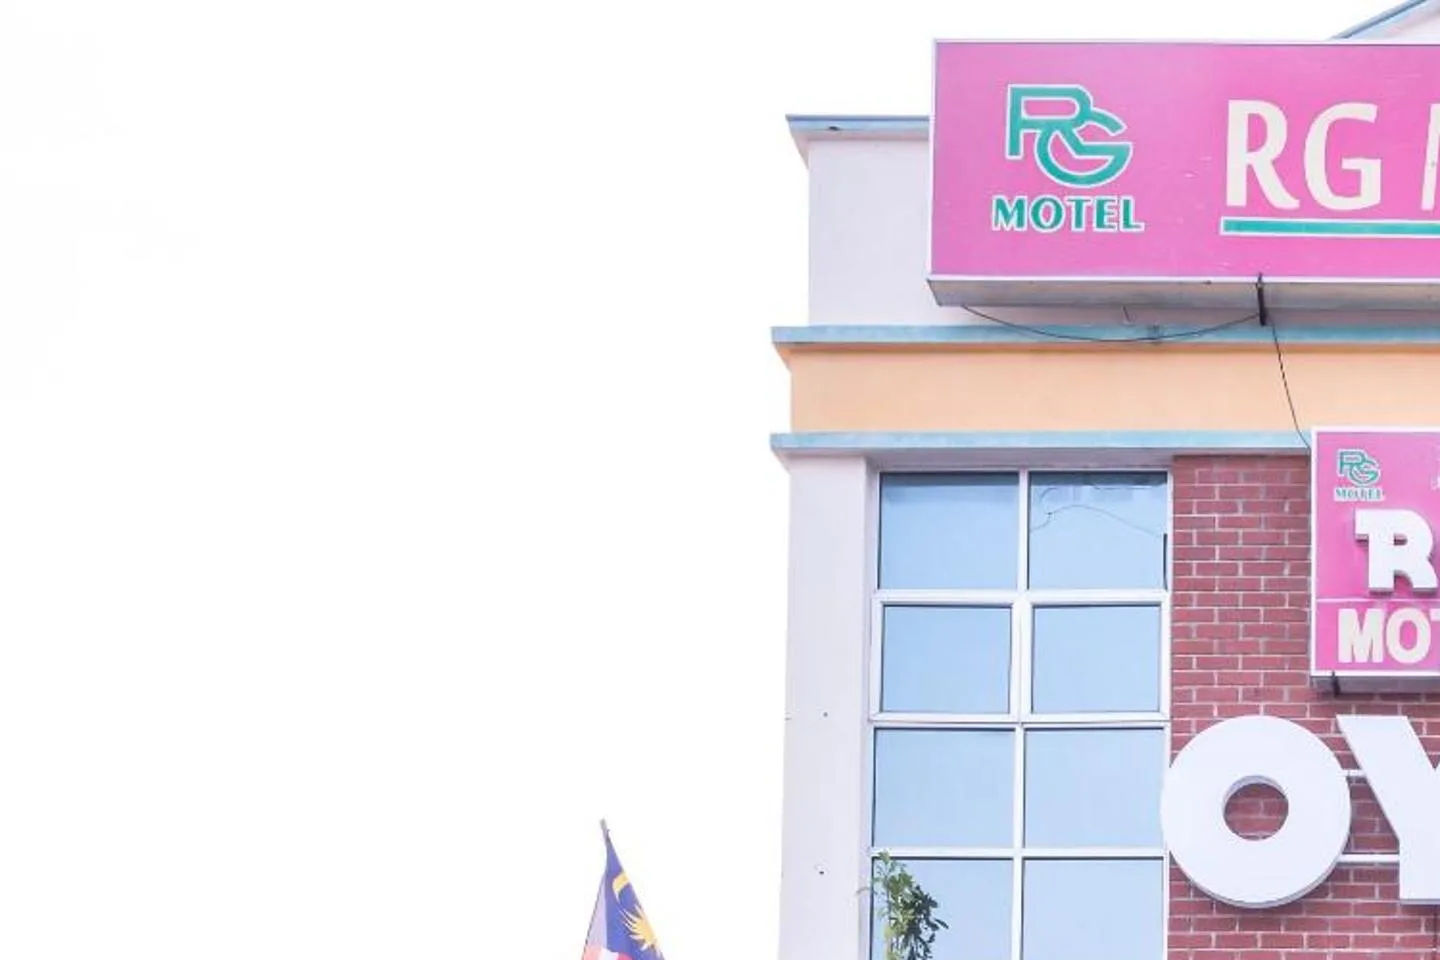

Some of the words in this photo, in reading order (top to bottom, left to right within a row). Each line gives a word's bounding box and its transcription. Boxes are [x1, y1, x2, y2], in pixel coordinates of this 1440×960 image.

[1004, 83, 1134, 189] RG
[1226, 99, 1382, 212] RG
[991, 195, 1145, 233] MOTEL
